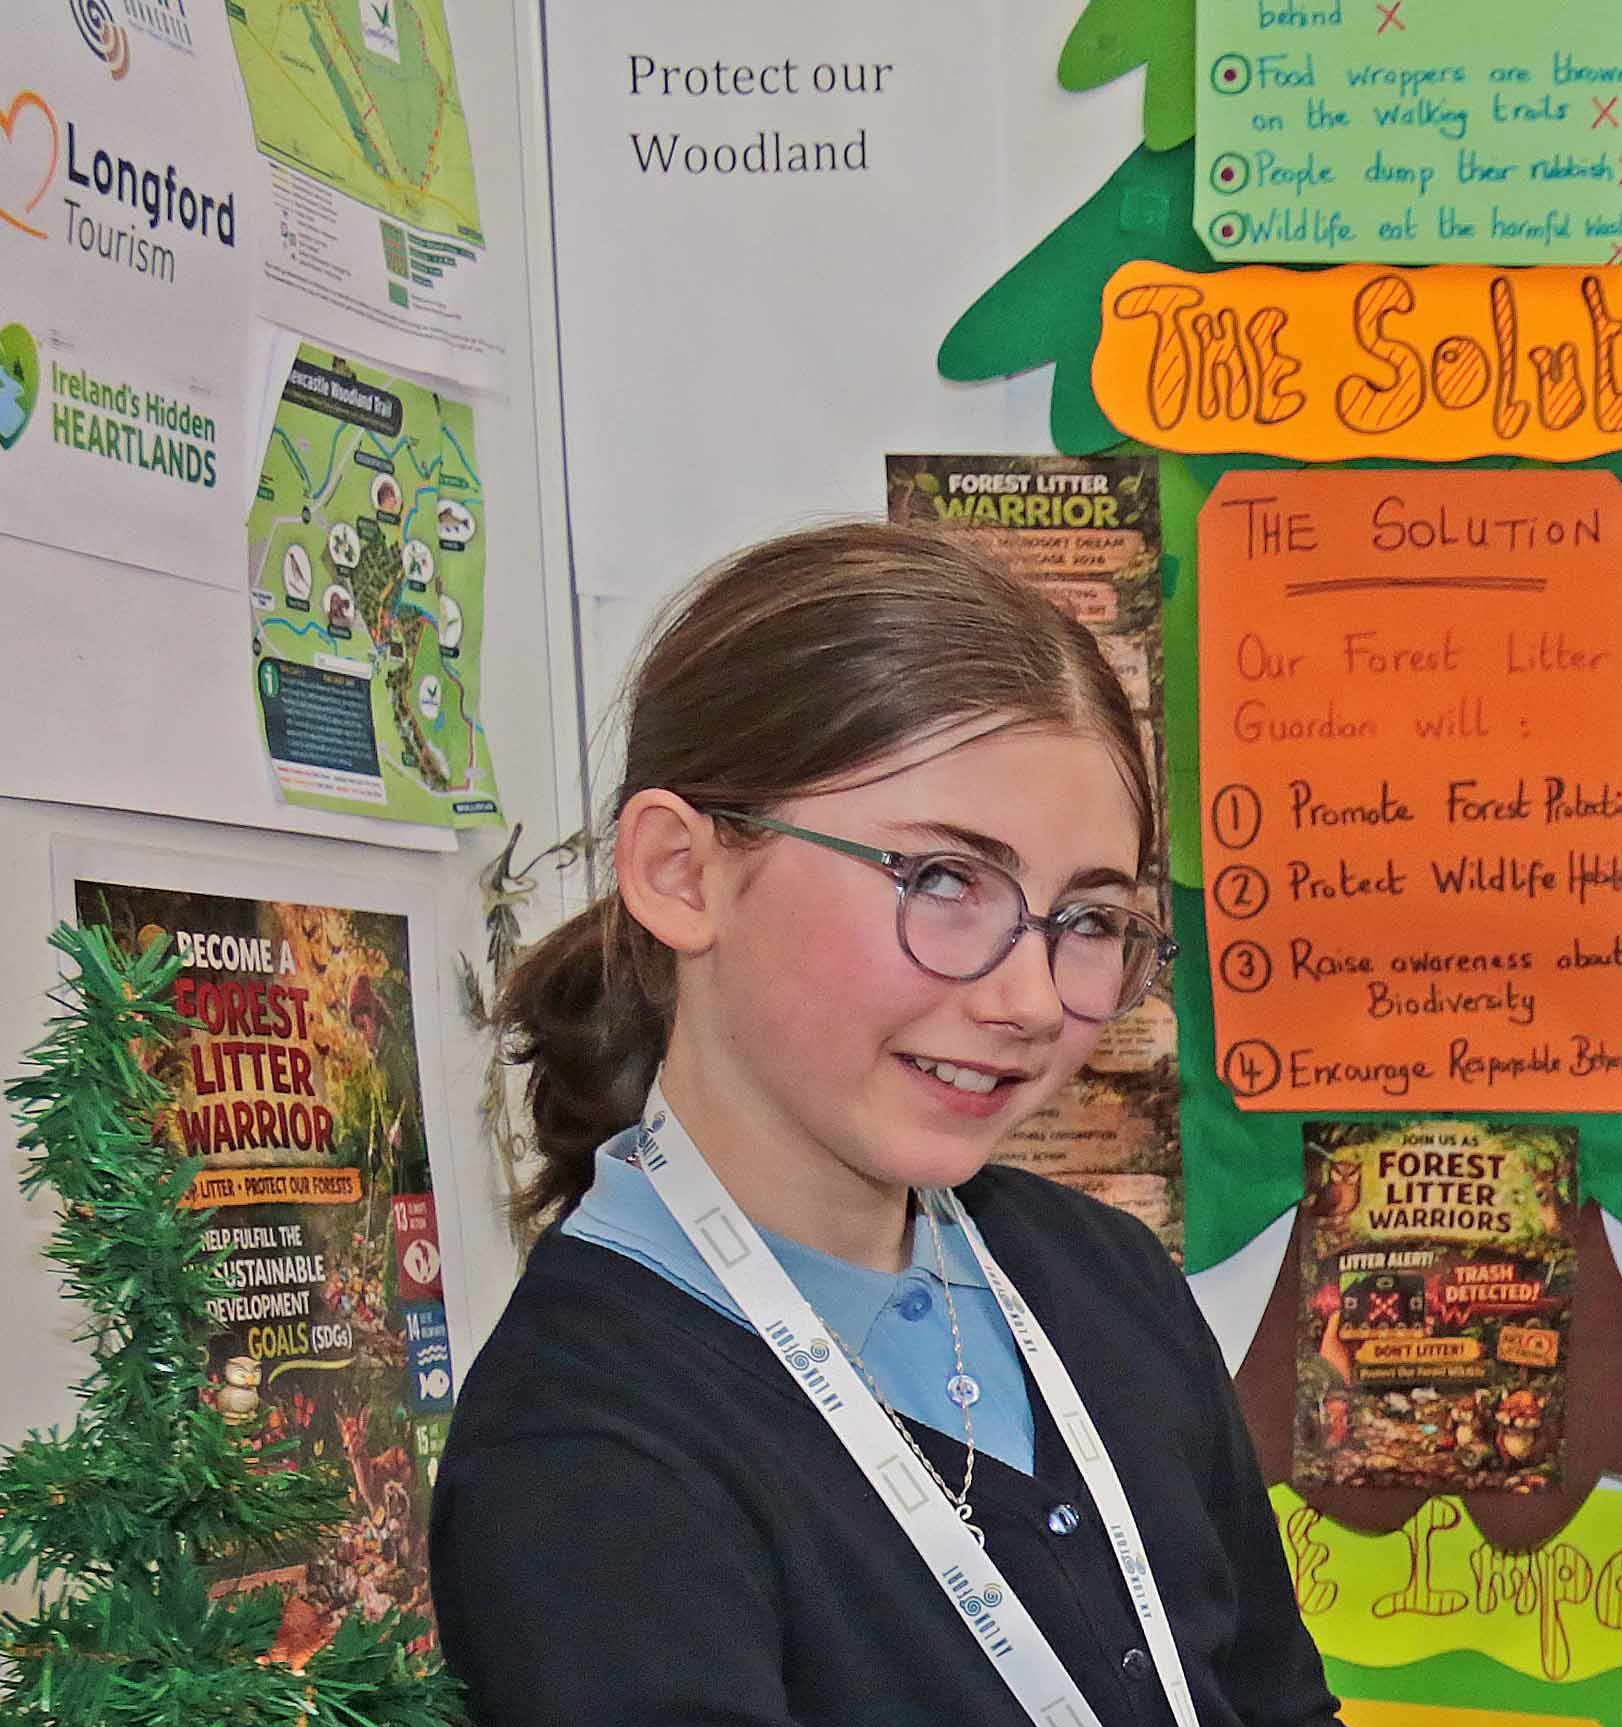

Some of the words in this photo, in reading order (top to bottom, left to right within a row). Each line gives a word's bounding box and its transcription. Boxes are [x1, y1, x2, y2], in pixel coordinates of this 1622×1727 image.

[1258, 0, 1342, 29] behind
[629, 54, 799, 96] Protect
[812, 58, 893, 93] our
[1256, 52, 1315, 88] Food
[1307, 100, 1350, 128] the
[631, 130, 870, 174] Woodland
[1255, 149, 1335, 195] People
[1365, 150, 1435, 194] dump
[1458, 146, 1517, 183] their
[1530, 154, 1615, 181] rubbish
[67, 123, 234, 247] Longford
[64, 198, 176, 284] Tourism
[1245, 209, 1355, 249] Wildlife
[1439, 208, 1473, 239] the
[1491, 208, 1570, 246] harmful
[1113, 283, 1307, 430] THE
[52, 361, 140, 419] Ireland's
[145, 388, 216, 443] Hidden
[53, 407, 217, 488] HEARTLANDS
[948, 474, 1031, 494] FOREST
[1036, 474, 1109, 494] LITTER
[933, 495, 1119, 528] WARRIOR
[1221, 496, 1317, 560] THE
[1236, 633, 1306, 681] Our
[1344, 630, 1462, 674] Forest
[1506, 630, 1609, 674] Litter
[1415, 699, 1489, 739] will
[1289, 778, 1414, 828] Promote
[1447, 778, 1530, 825] Forest
[1289, 857, 1406, 899] Protect
[1432, 852, 1556, 896] Wildlife
[177, 930, 273, 969] BECOME
[278, 942, 297, 975] A
[1291, 938, 1373, 979] Raise
[1392, 946, 1532, 972] awareness
[175, 977, 309, 1040] FOREST
[1368, 980, 1535, 1023] Biodiversity
[190, 1040, 315, 1097] LITTER
[1291, 1050, 1432, 1094] Encourage
[177, 1100, 338, 1154] WARRIOR
[1378, 1151, 1506, 1179] FOREST
[200, 1179, 235, 1198] LITTER
[245, 1177, 287, 1195] PROTECT
[291, 1177, 310, 1193] OUR
[312, 1177, 353, 1193] FORESTS
[1387, 1181, 1496, 1206] LITTER
[200, 1230, 231, 1251] HELP
[234, 1227, 277, 1248] FULFILL
[279, 1225, 302, 1246] THE
[1368, 1208, 1512, 1232] WARRIORS
[212, 1255, 326, 1288] USTAINABLE
[1455, 1264, 1514, 1282] TRASH
[207, 1291, 310, 1322] DEVELOPMENT
[1446, 1283, 1540, 1303] DETECTED!
[248, 1322, 309, 1361] GOALS
[312, 1324, 352, 1354] (SDGs)
